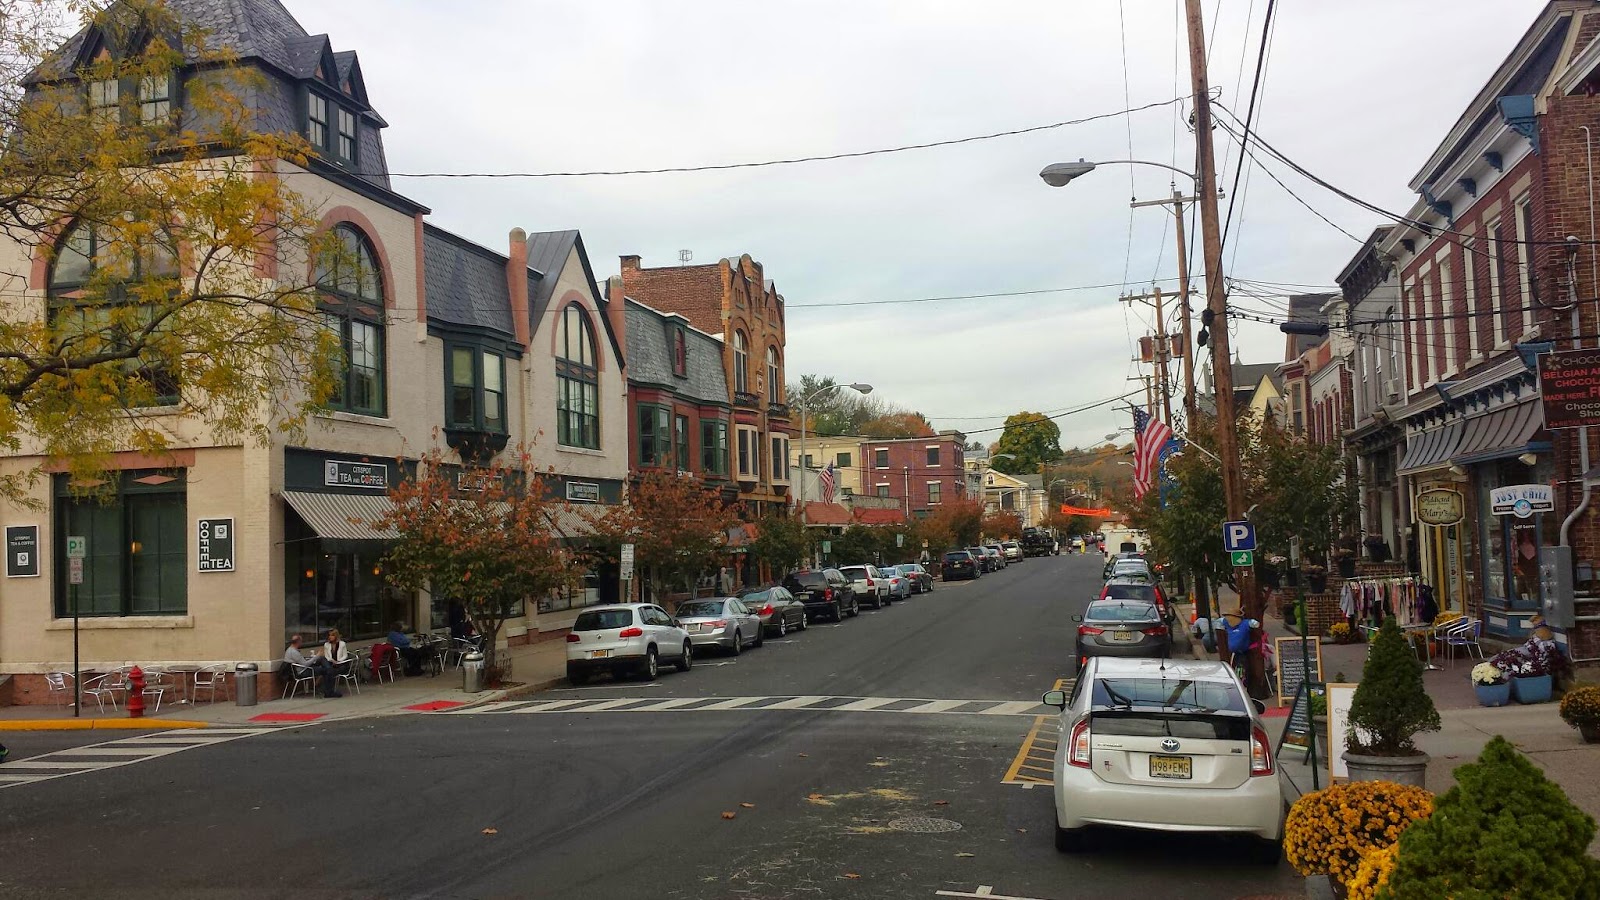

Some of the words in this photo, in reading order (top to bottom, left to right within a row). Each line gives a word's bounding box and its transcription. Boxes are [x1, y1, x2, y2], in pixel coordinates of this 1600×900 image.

[1543, 370, 1588, 379] BELGIAN
[1555, 378, 1600, 387] CHOCOL
[340, 473, 352, 483] TEA
[1495, 490, 1517, 503] JUST
[1230, 525, 1249, 547] P
[69, 541, 77, 554] P
[200, 521, 210, 569] COFFEE
[210, 558, 231, 568] TEA
